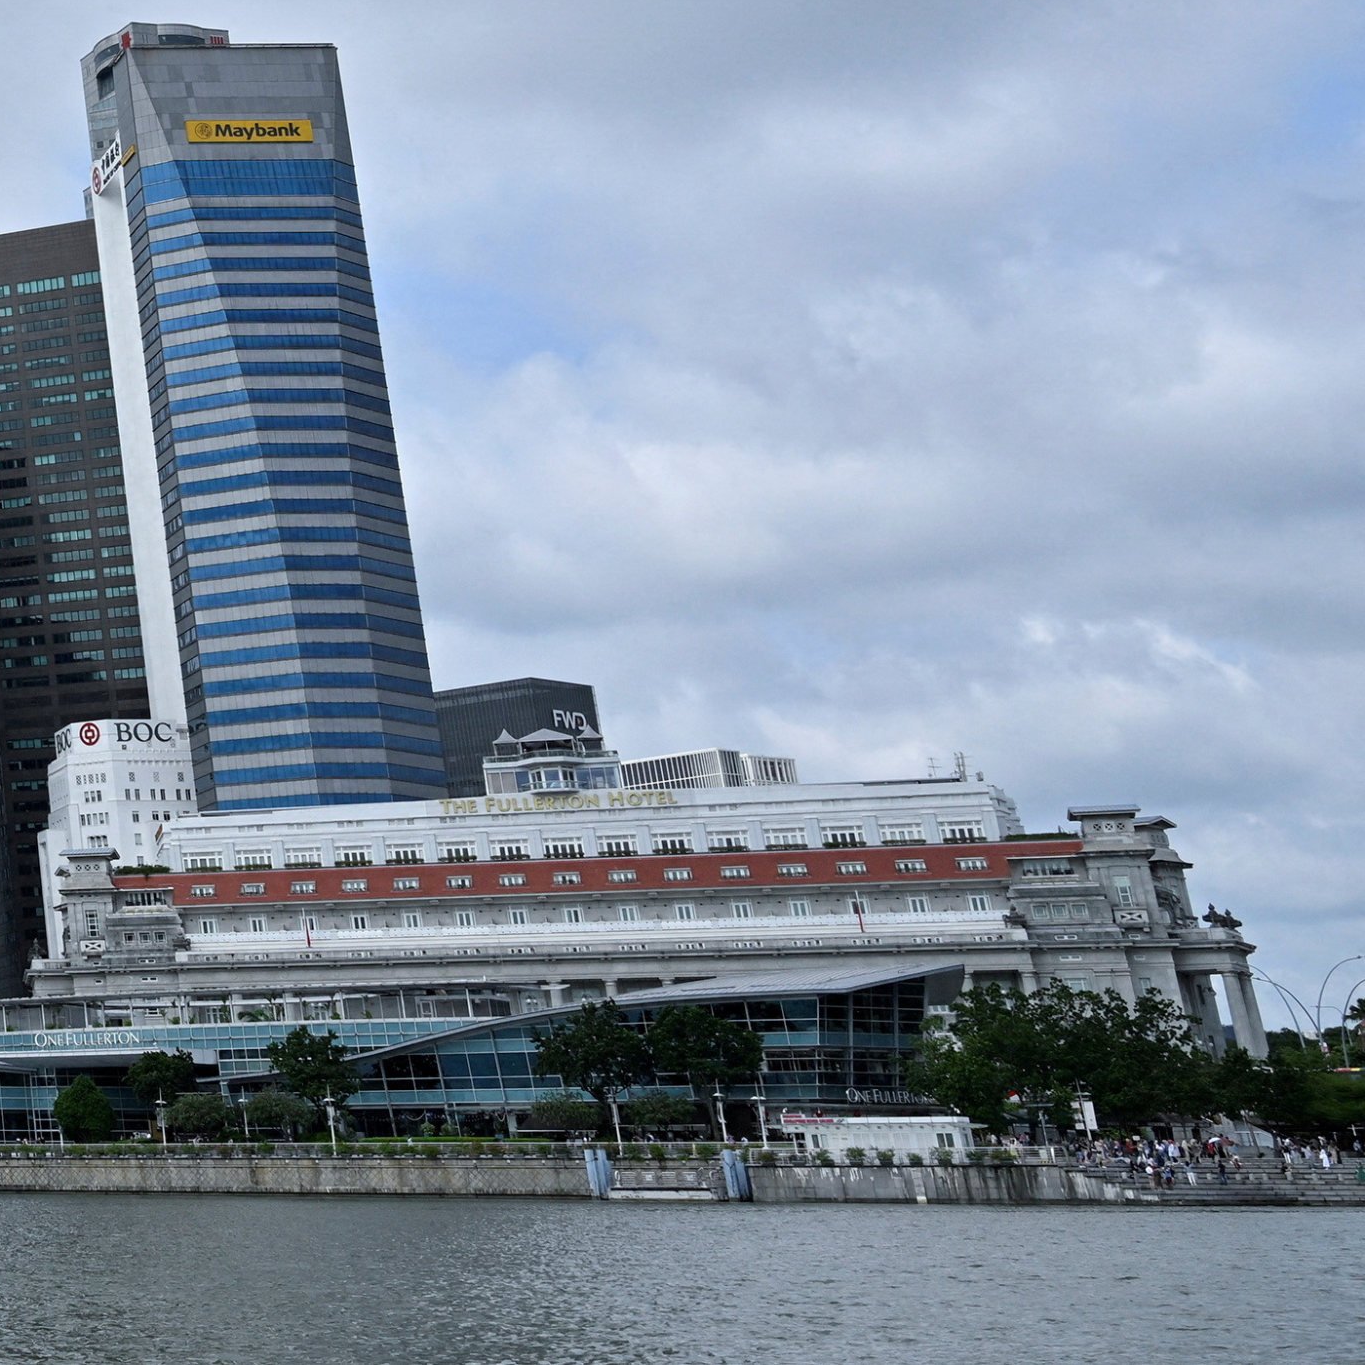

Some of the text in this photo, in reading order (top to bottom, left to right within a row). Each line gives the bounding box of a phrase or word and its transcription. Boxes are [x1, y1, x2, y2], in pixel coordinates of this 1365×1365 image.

[215, 122, 301, 140] Maybank
[552, 709, 587, 731] FWD
[55, 728, 72, 754] BOC
[114, 722, 173, 743] BOC
[439, 790, 678, 815] THE FULLERTON HOTEL
[66, 1031, 140, 1046] FULLERTON
